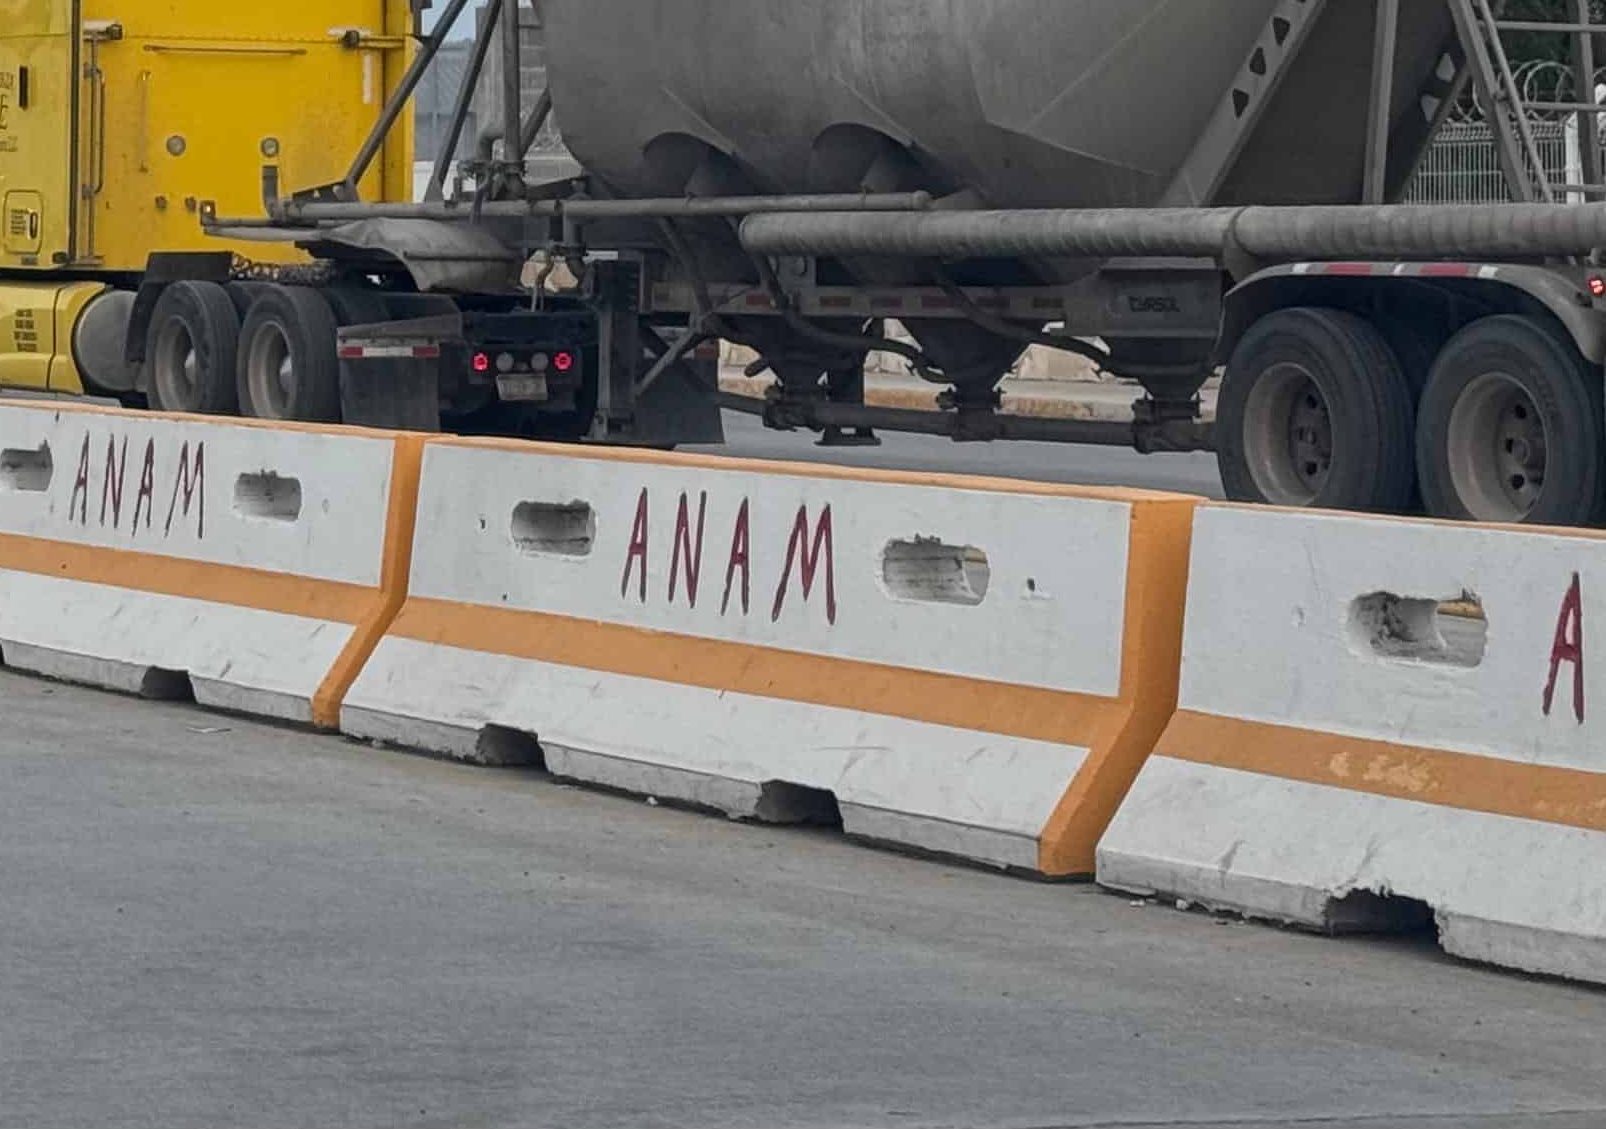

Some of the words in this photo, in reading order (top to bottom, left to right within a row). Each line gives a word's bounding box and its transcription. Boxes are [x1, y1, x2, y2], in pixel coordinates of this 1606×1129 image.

[69, 429, 204, 540] ANAM
[621, 486, 836, 625] ANAM
[1542, 571, 1584, 725] A
